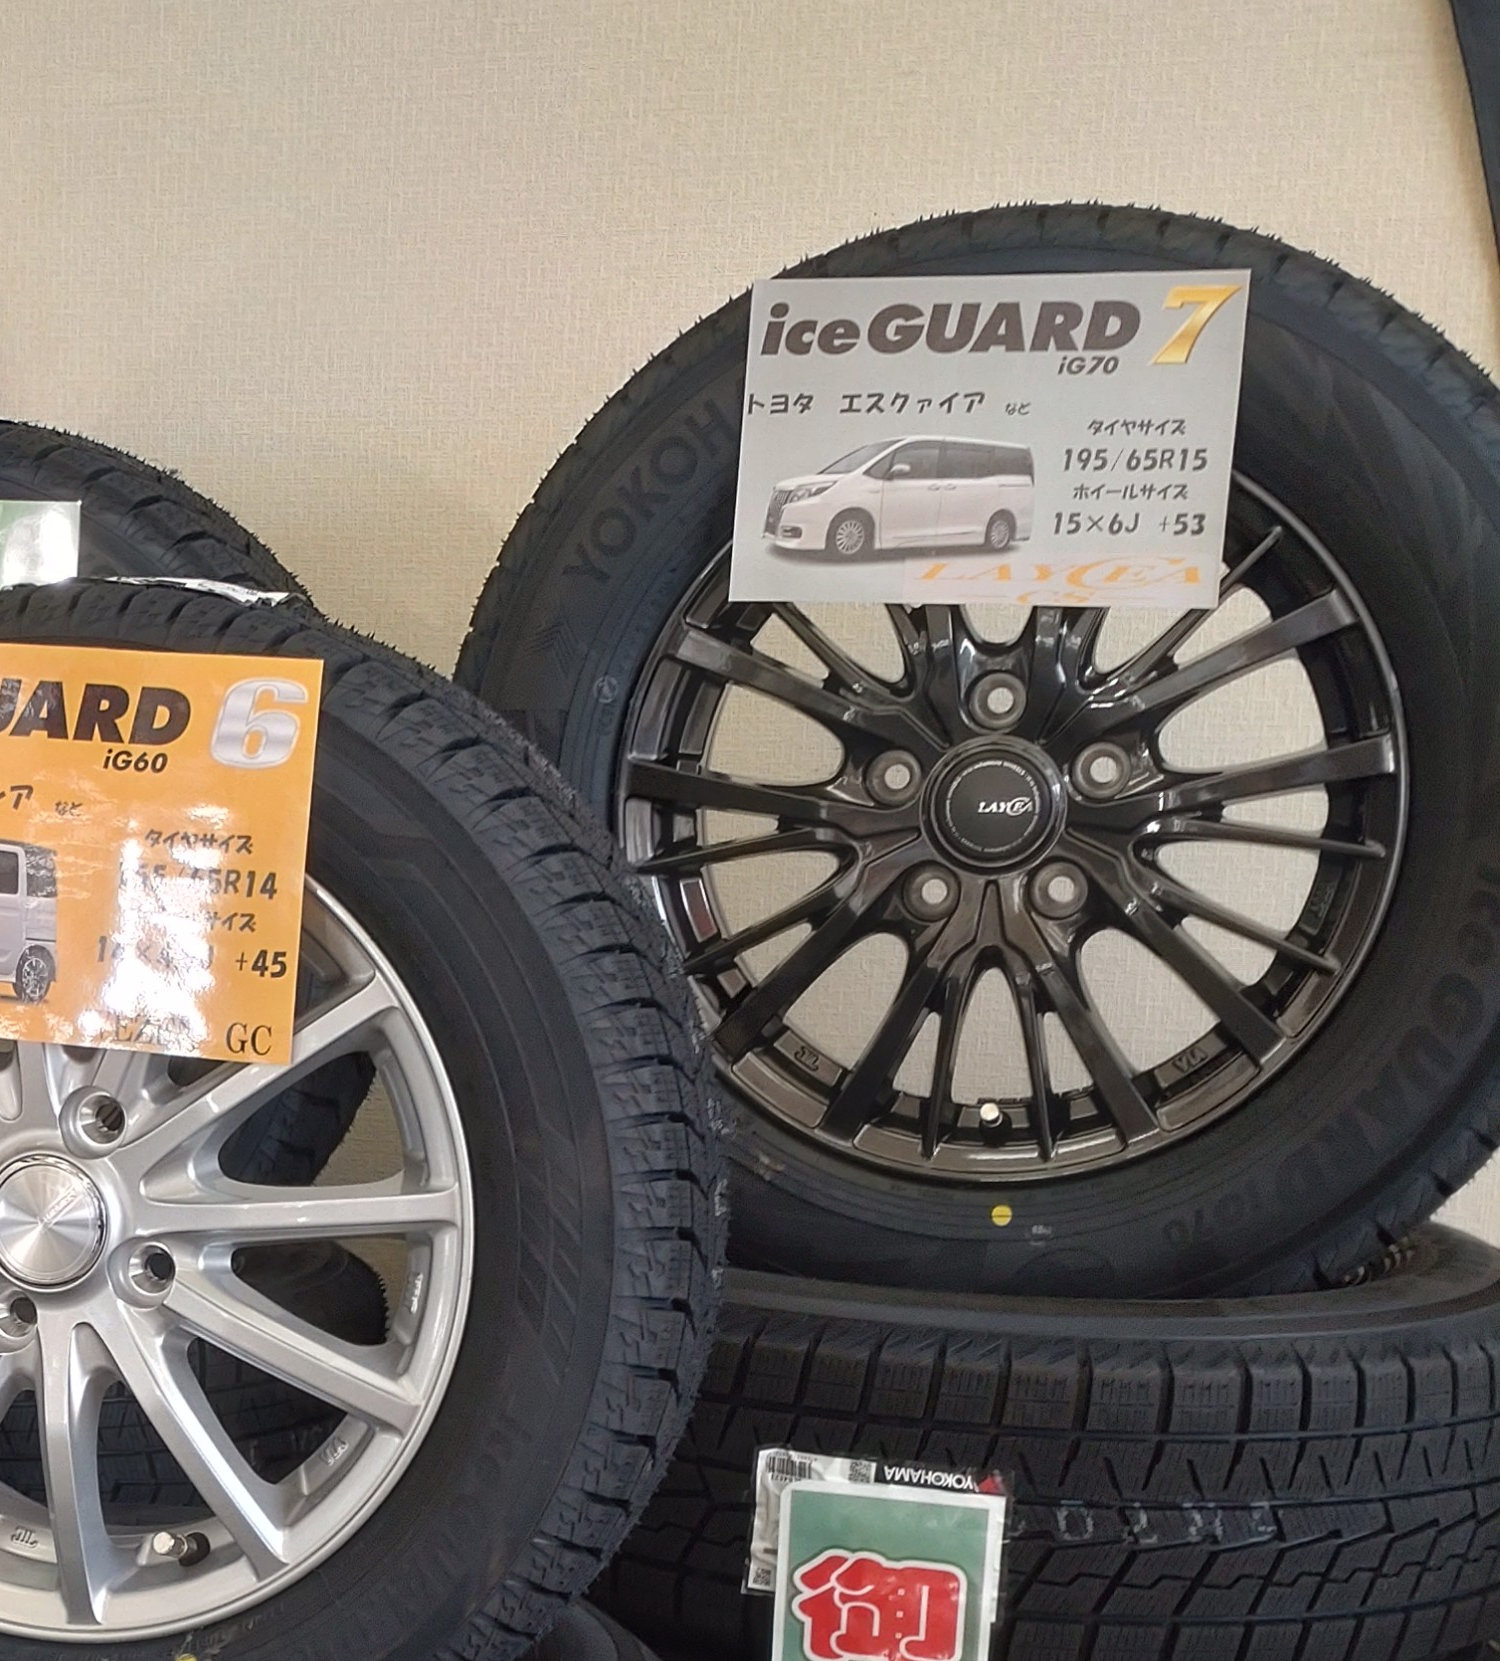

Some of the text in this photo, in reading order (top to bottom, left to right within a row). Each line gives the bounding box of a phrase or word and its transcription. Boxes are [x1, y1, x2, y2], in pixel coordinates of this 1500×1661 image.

[760, 284, 1244, 366] iceGUARD 7
[1057, 356, 1119, 376] iG70
[746, 393, 814, 416] トヨタ
[840, 392, 986, 416] エスクァイア
[1087, 419, 1187, 436] タイヤサイズ
[1063, 448, 1208, 472] 195/65R15
[1073, 483, 1189, 501] ホイールサイズ
[1159, 513, 1206, 536] +53
[209, 677, 310, 771] 6
[102, 749, 168, 774] iG60
[144, 829, 254, 854] タイヤサイズ
[235, 949, 288, 978] +45
[226, 1021, 273, 1056] GC
